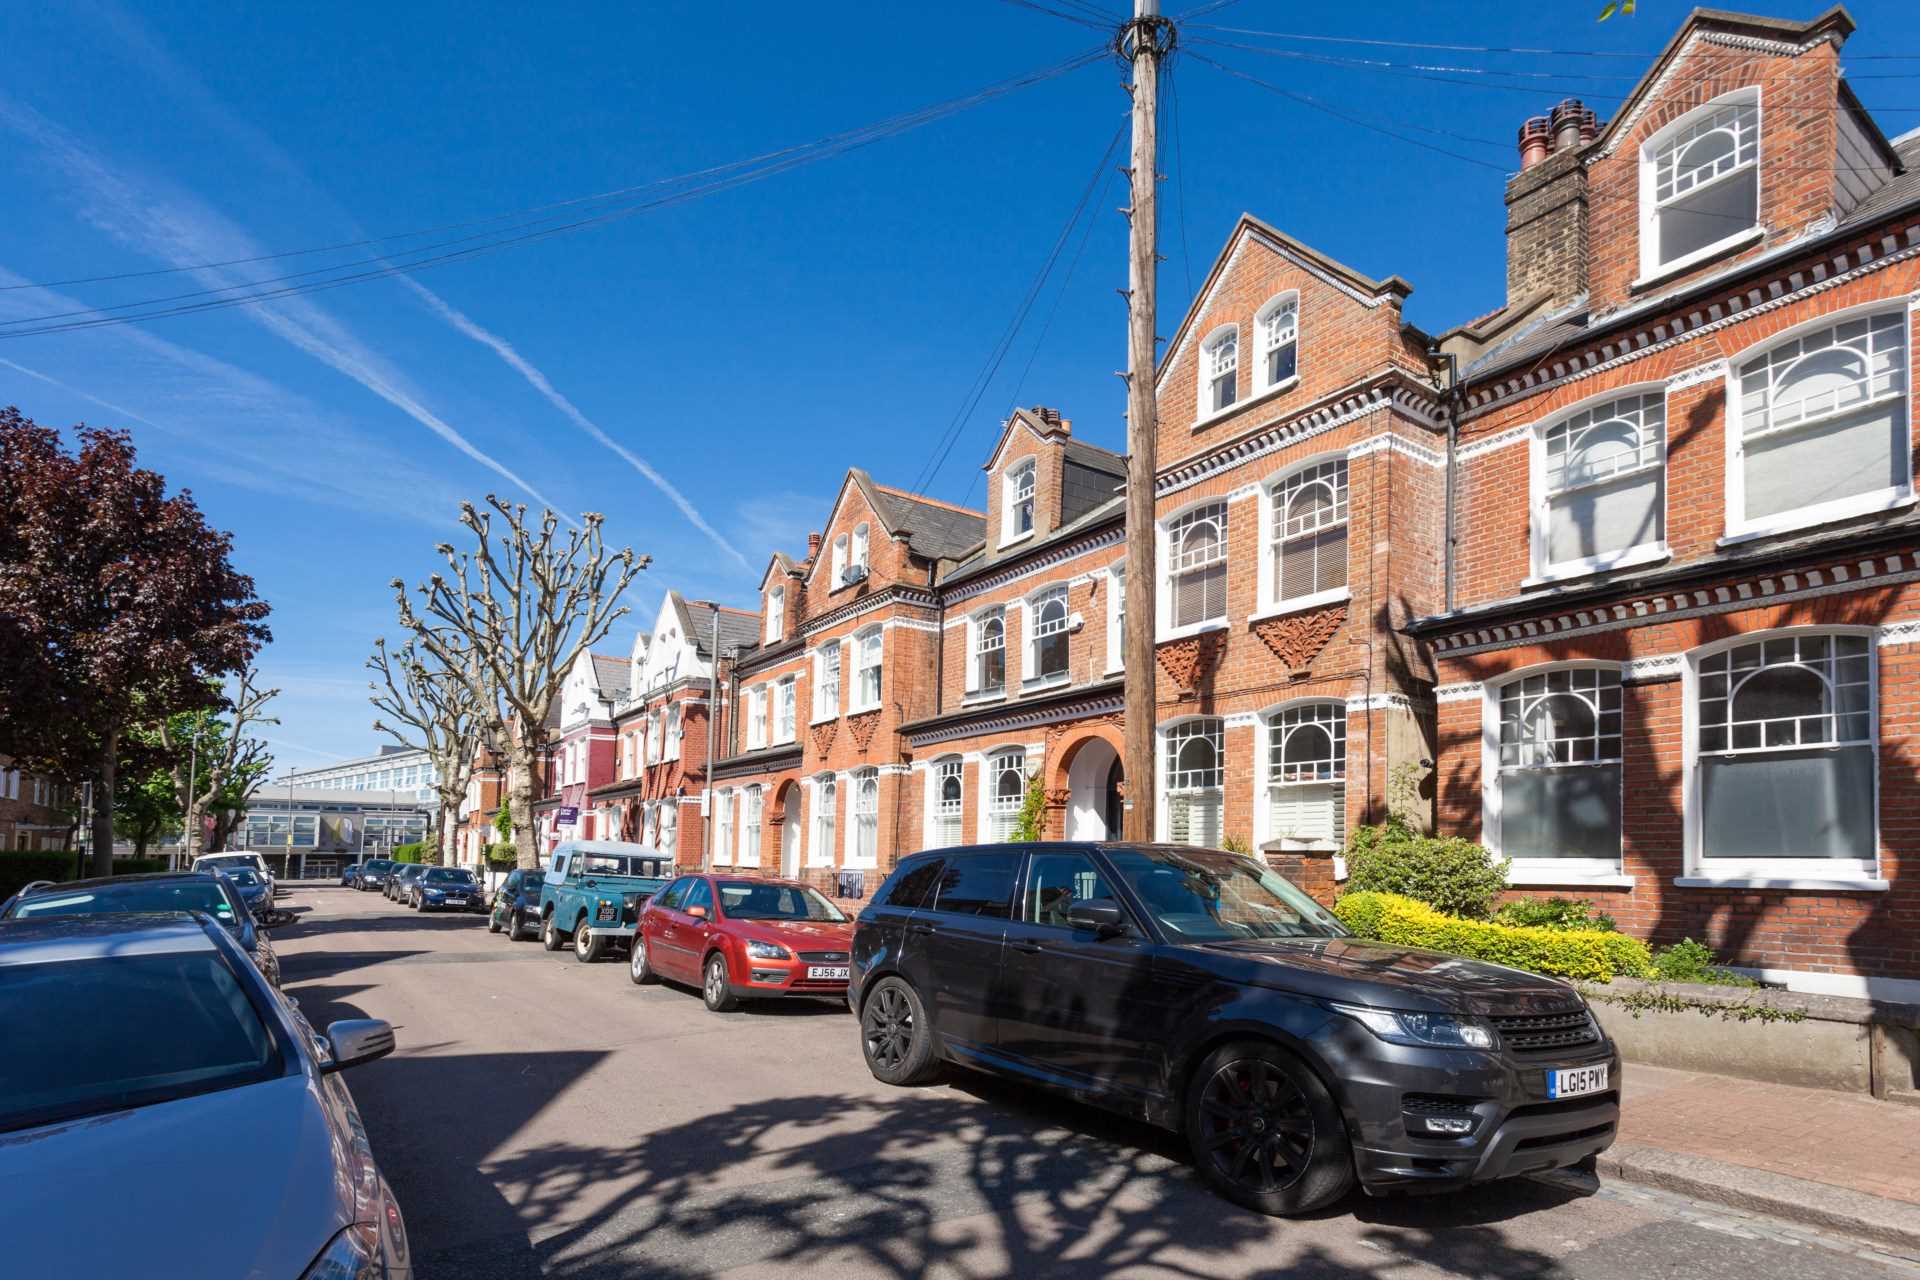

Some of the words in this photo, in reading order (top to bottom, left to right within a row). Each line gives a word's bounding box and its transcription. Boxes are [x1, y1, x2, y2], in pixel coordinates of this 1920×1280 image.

[812, 968, 836, 977] EJ56
[837, 968, 849, 977] JX
[1560, 1071, 1587, 1093] LG15
